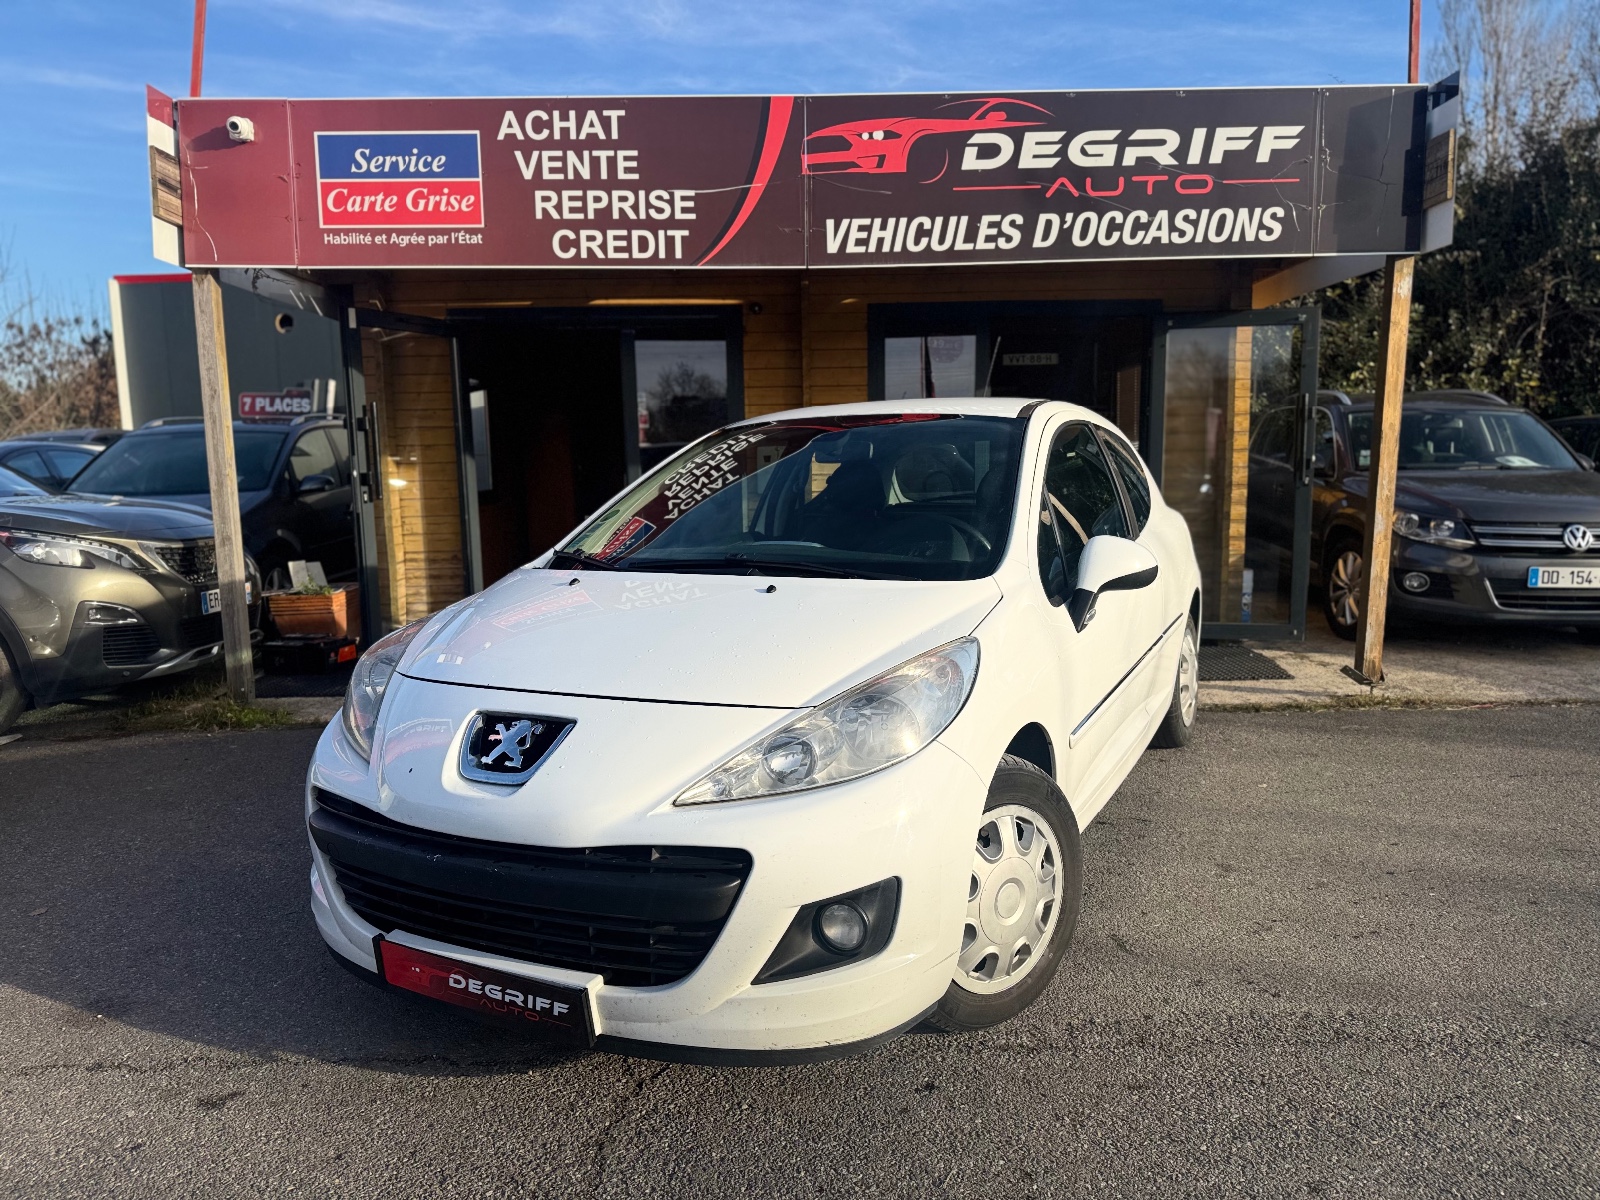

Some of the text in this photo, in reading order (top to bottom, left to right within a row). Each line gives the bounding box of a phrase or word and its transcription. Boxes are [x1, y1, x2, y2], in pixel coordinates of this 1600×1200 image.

[497, 109, 626, 141] ACHAT
[351, 147, 446, 173] Service
[961, 125, 1306, 171] DEGRIFF
[514, 150, 640, 180] VENTE
[326, 187, 475, 213] Carte Grise
[1045, 174, 1214, 198] AUTO
[534, 189, 697, 220] REPRISE
[324, 231, 372, 246] Habilité
[375, 233, 387, 245] et
[390, 231, 425, 248] Agrée
[428, 235, 448, 247] par
[552, 229, 690, 259] CREDIT
[825, 206, 1285, 254] VEHICULES D'OCCASIONS
[243, 397, 311, 413] 7 PLACES
[448, 973, 571, 1017] DEGRIFF
[480, 998, 540, 1022] AUTO
